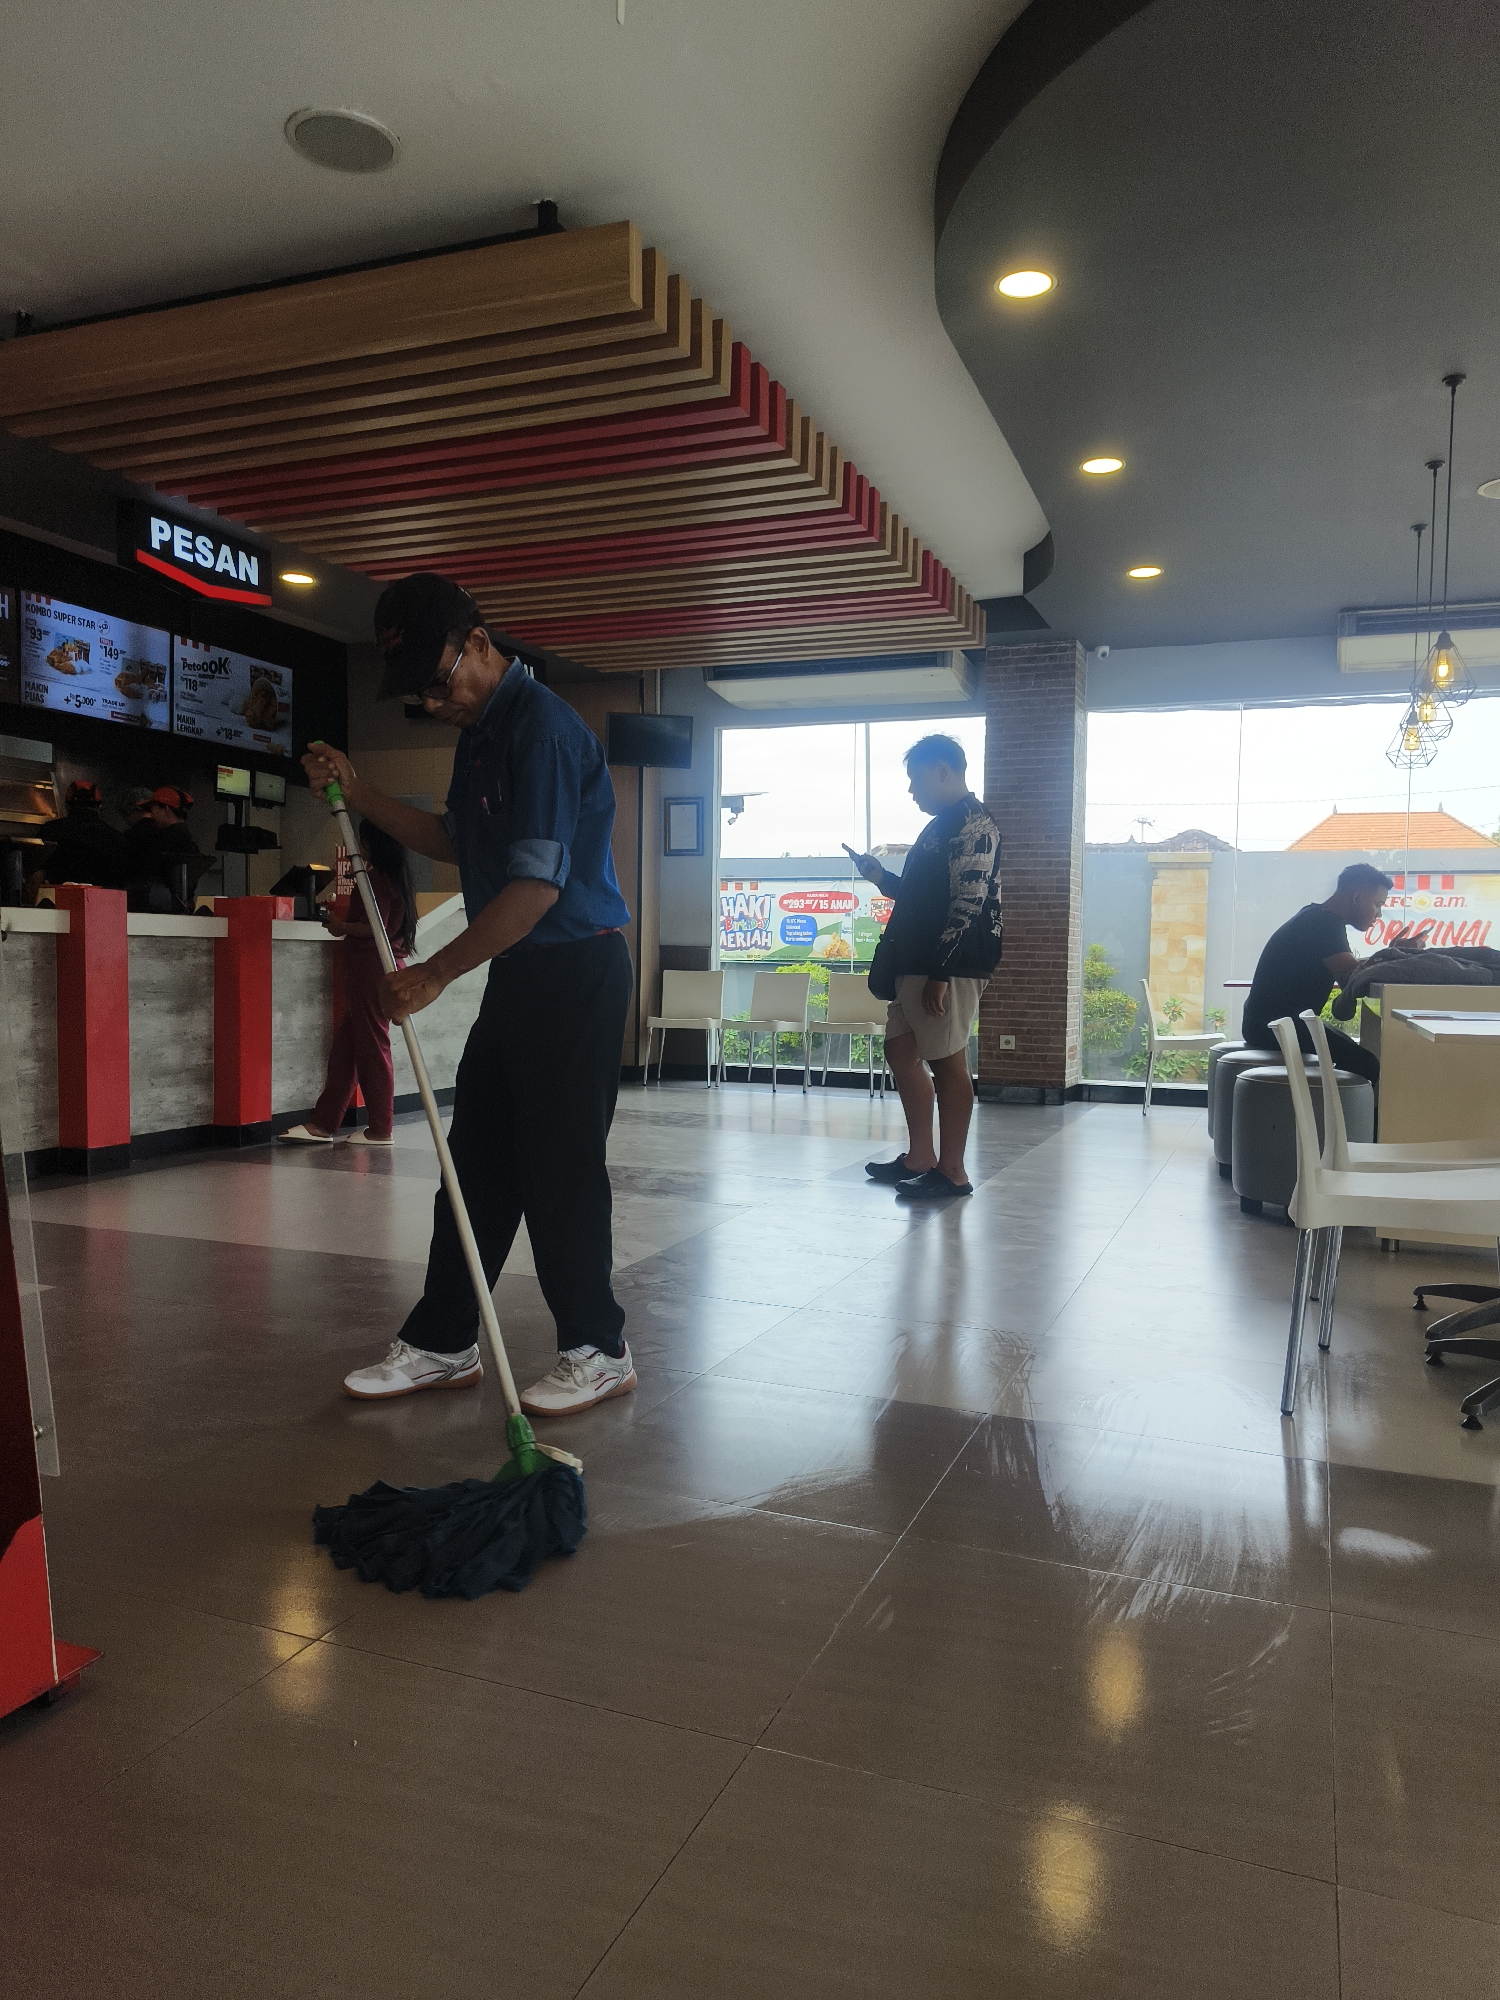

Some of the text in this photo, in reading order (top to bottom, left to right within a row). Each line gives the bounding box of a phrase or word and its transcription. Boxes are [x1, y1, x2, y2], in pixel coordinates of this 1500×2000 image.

[151, 517, 258, 586] PESAN
[25, 602, 51, 618] KOMBO
[53, 610, 76, 625] SUPER
[78, 617, 96, 630] STAR
[25, 681, 49, 694] MAKIN
[25, 691, 45, 704] PUAS
[177, 713, 196, 726] MAKIN
[177, 723, 204, 736] LENGKAP
[720, 894, 771, 919] HAKI
[1433, 895, 1468, 908] a.m.
[1365, 917, 1492, 948] ORIGINAL
